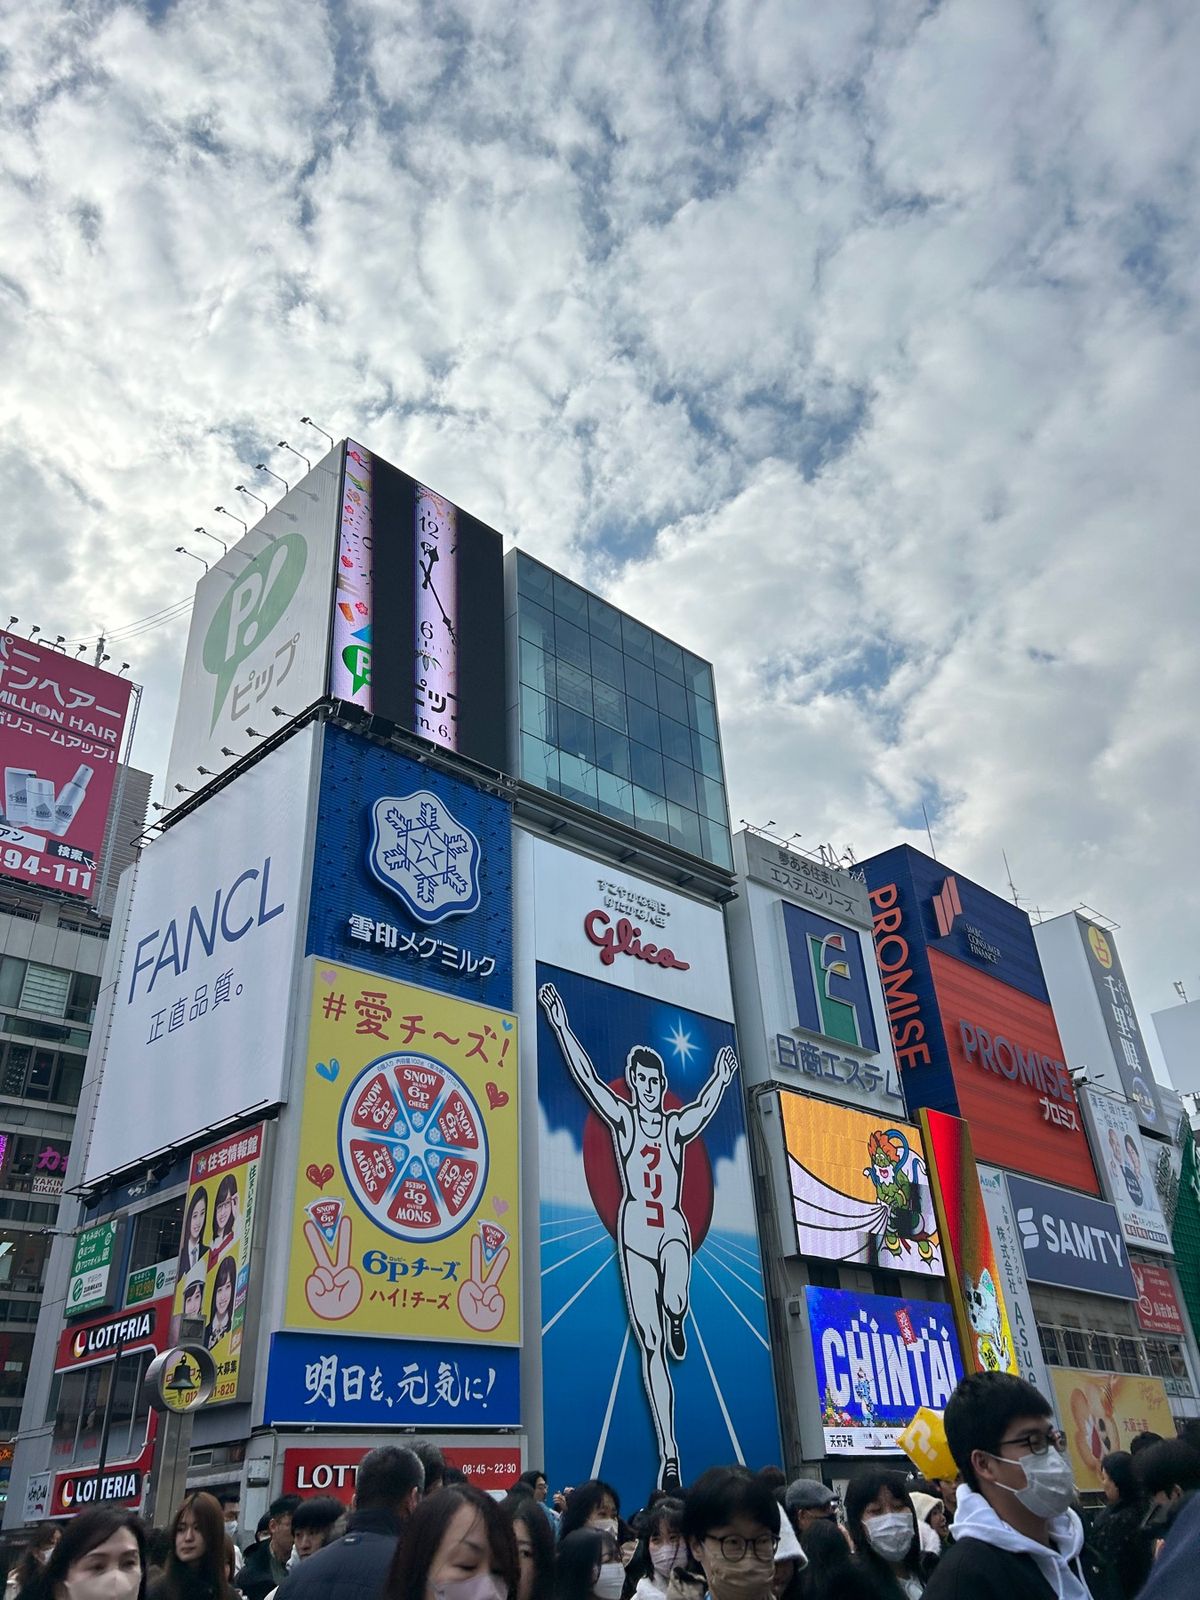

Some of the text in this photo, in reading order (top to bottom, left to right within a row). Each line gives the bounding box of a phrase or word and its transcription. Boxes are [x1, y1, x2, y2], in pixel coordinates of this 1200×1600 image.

[231, 632, 300, 721] ピップ
[69, 715, 118, 743] HAIR
[0, 846, 92, 891] 94-111
[771, 868, 856, 916] エステムシリーズ
[128, 856, 285, 1005] FANCL
[348, 913, 496, 976] 雪印メグミルク
[585, 909, 690, 970] Glico
[868, 883, 933, 1070] PROMISE
[146, 968, 243, 1044] 正直品質。
[403, 1069, 437, 1086] SNOW
[959, 1019, 1073, 1101] PROMISE
[357, 1080, 383, 1119] SNOW
[382, 1107, 398, 1129] CHEESE
[408, 1099, 429, 1110] CHEESE
[453, 1101, 476, 1141] SNOW
[1039, 1097, 1081, 1132] プロミス
[208, 1134, 259, 1172] 住宅情報館
[353, 1150, 378, 1193] SNOW
[405, 1180, 427, 1191] CHEESE
[451, 1168, 474, 1208] SNOW
[640, 1142, 665, 1228] グリコ
[396, 1207, 432, 1224] SNOW
[996, 1224, 1019, 1295] 株式会社
[1041, 1214, 1124, 1268] SAMTY
[88, 1314, 150, 1352] LOTTERIA
